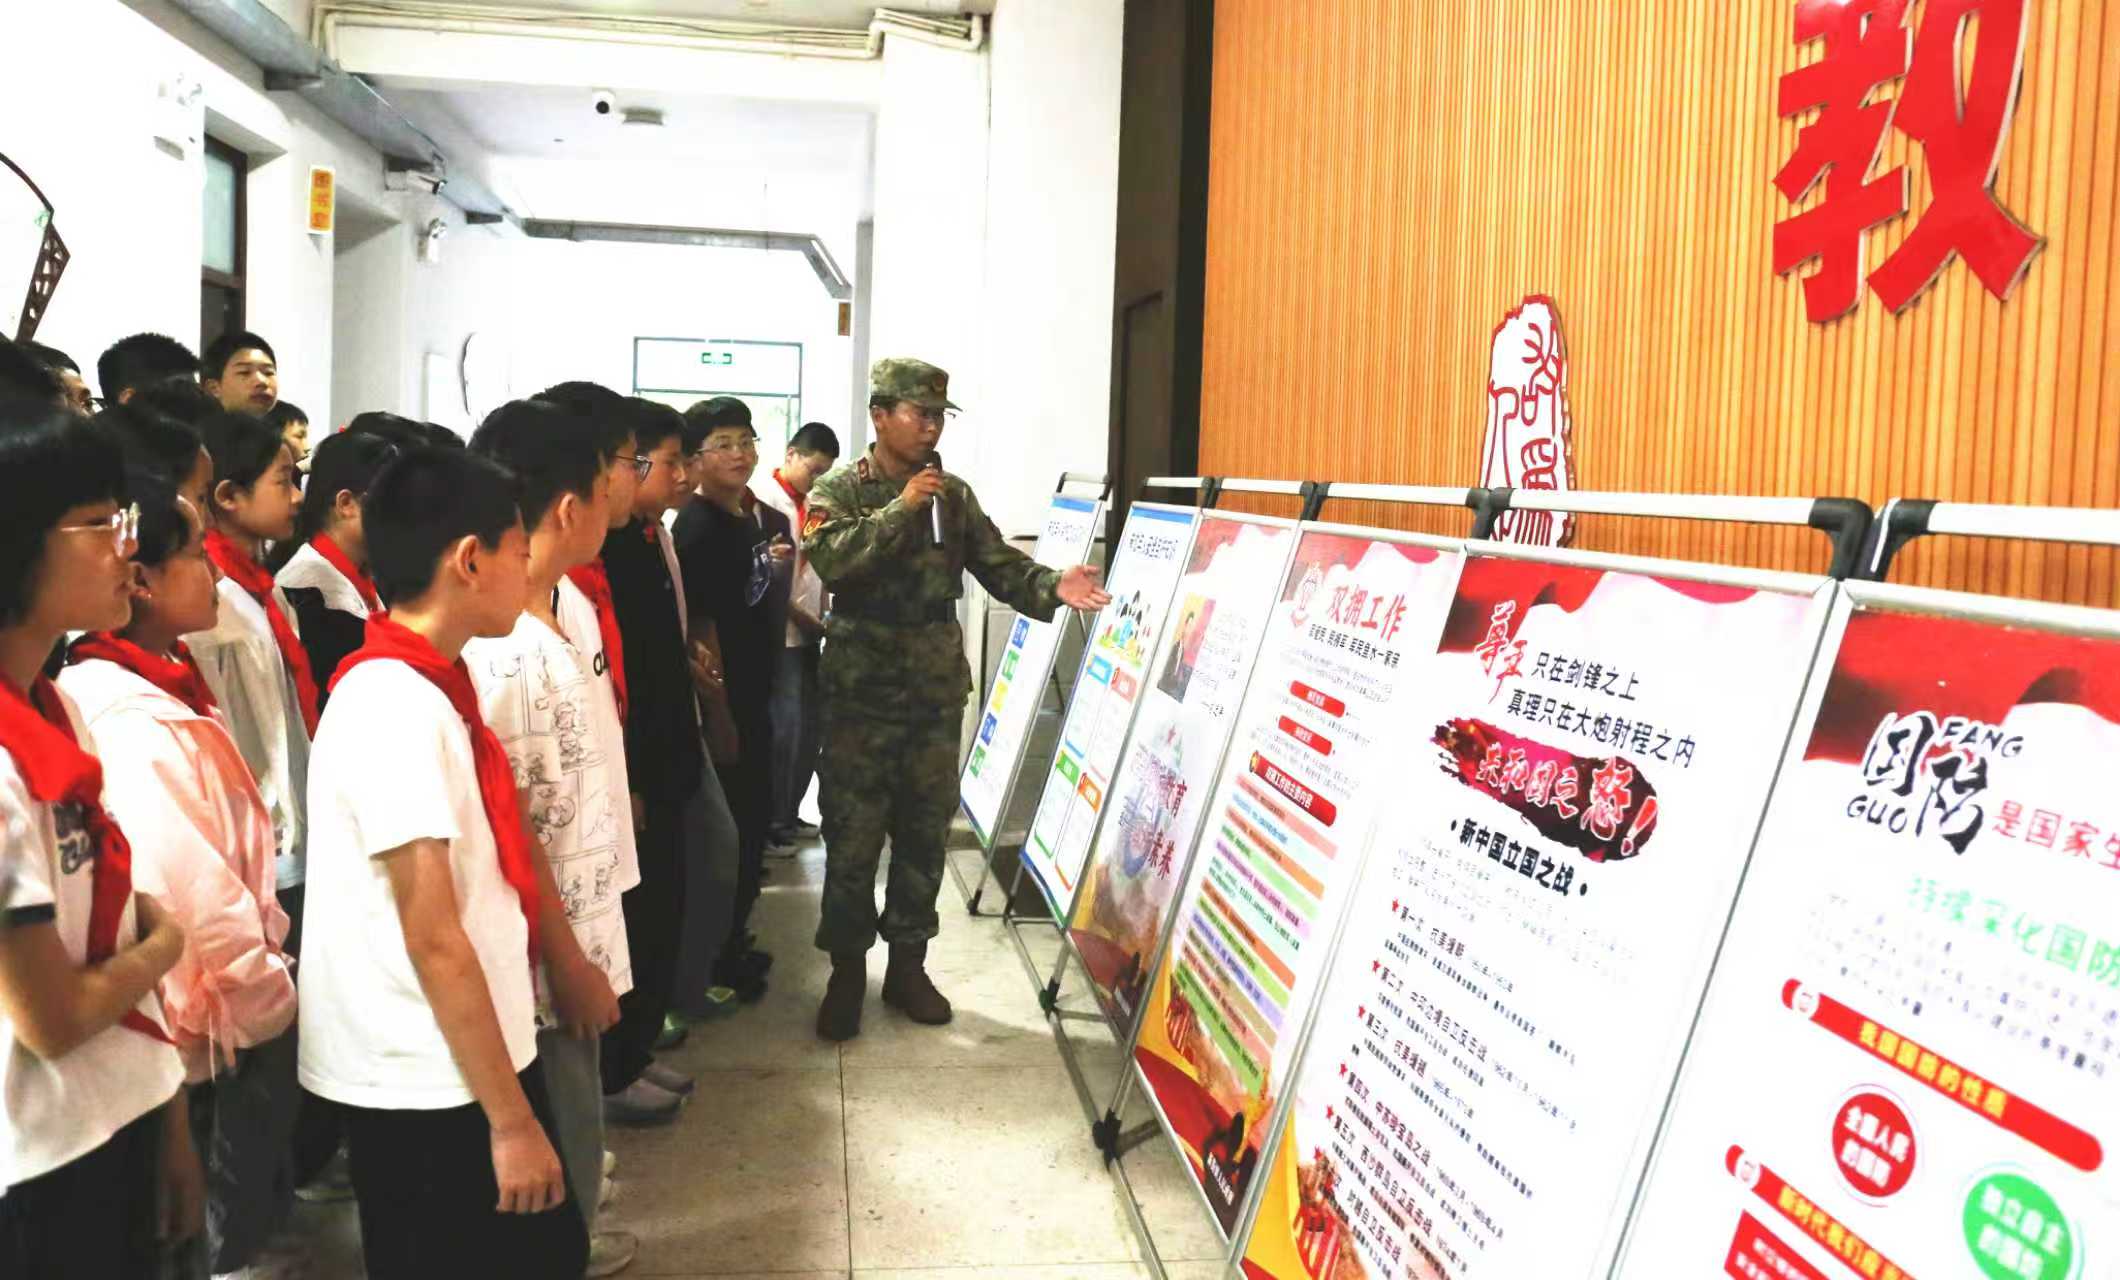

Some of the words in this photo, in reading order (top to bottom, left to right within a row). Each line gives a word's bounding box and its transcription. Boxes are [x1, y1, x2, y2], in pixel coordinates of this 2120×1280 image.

[1772, 0, 2047, 323] 教
[1327, 584, 1406, 641] 双拥工作
[1531, 651, 1640, 701] 只在剑锋之上
[1507, 688, 1696, 768] 真理只在大炮射程之内
[1943, 721, 2024, 758] FANG
[1847, 795, 1908, 834] GUO
[1863, 714, 1988, 855] 国防
[1458, 817, 1576, 897] 新中国立国之战
[1400, 906, 1424, 932] 第一次
[1430, 928, 1465, 959] 抗美援朝
[1380, 966, 1404, 992] 第二次
[1365, 1011, 1390, 1042] 第三次
[1393, 1038, 1428, 1079] 抗美援越
[1859, 1020, 2008, 1118] 我国国防的性质
[1346, 1071, 1371, 1104] 第四次
[1374, 1100, 1432, 1168] 中苏珍宝岛之战
[1843, 1105, 1911, 1164] 全国人民
[1347, 1188, 1402, 1265] 对越自卫反击战
[1360, 1144, 1433, 1238] 西沙群岛自卫反击战
